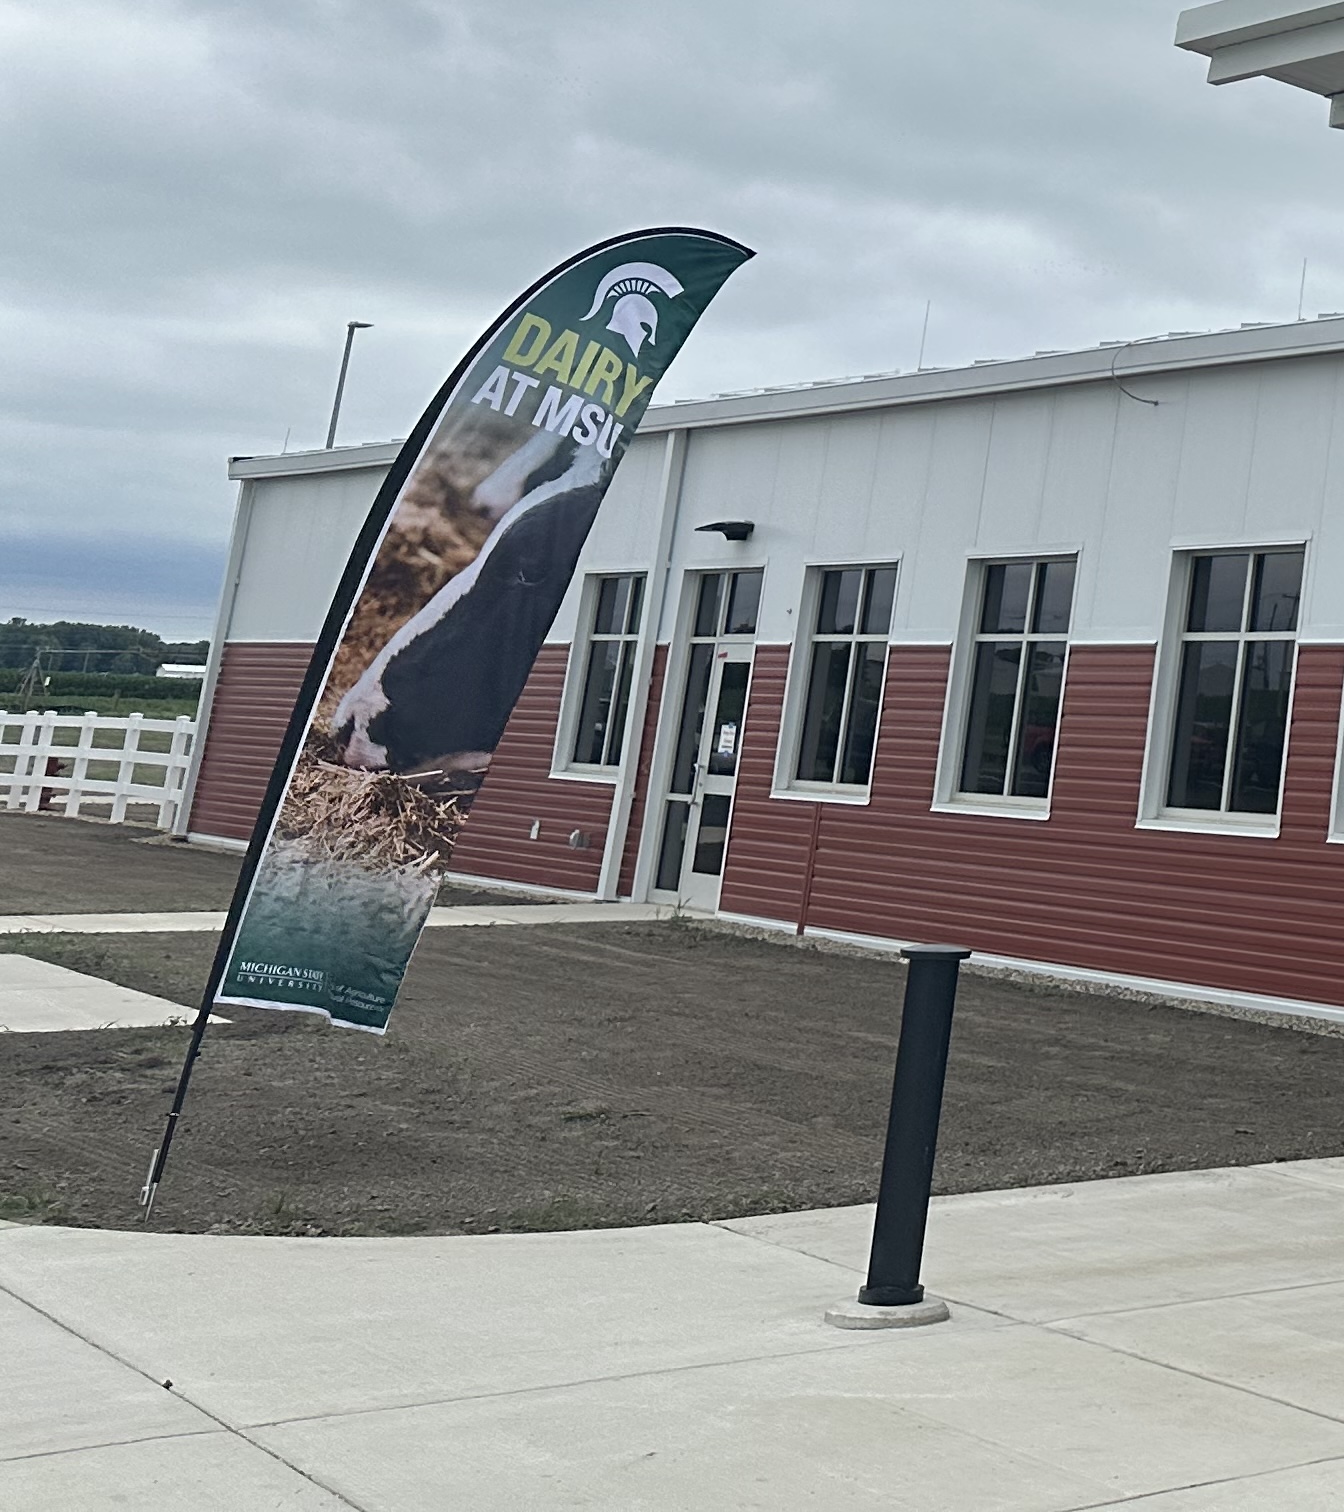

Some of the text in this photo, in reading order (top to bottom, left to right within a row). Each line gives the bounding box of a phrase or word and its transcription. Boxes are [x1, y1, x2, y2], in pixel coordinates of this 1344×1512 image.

[502, 312, 653, 418] DAIRY
[471, 365, 624, 459] AT MSU
[236, 974, 323, 992] UNIVERSITY
[240, 961, 302, 977] MICHIGAN
